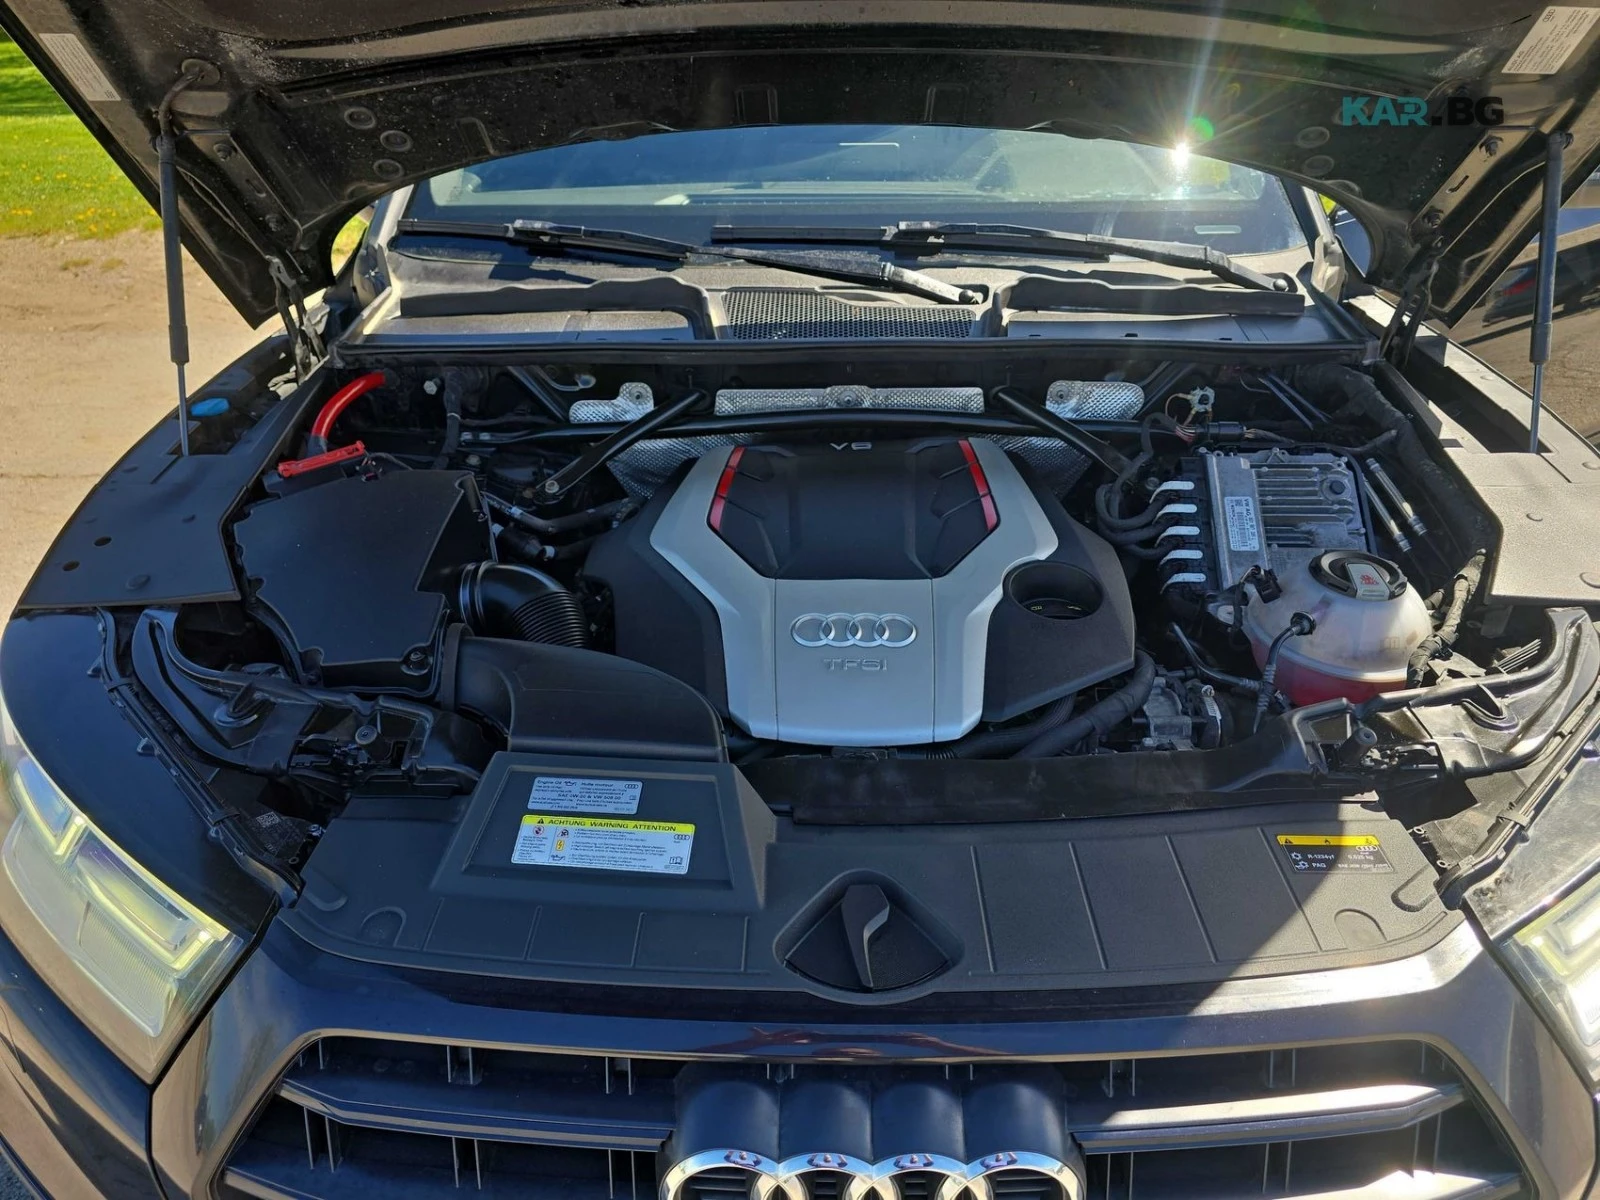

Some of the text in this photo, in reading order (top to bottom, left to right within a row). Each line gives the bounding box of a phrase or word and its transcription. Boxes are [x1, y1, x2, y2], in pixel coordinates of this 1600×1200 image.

[823, 659, 887, 671] TFSI
[548, 819, 677, 832] ACHTUNG WARNING ATTENTION
